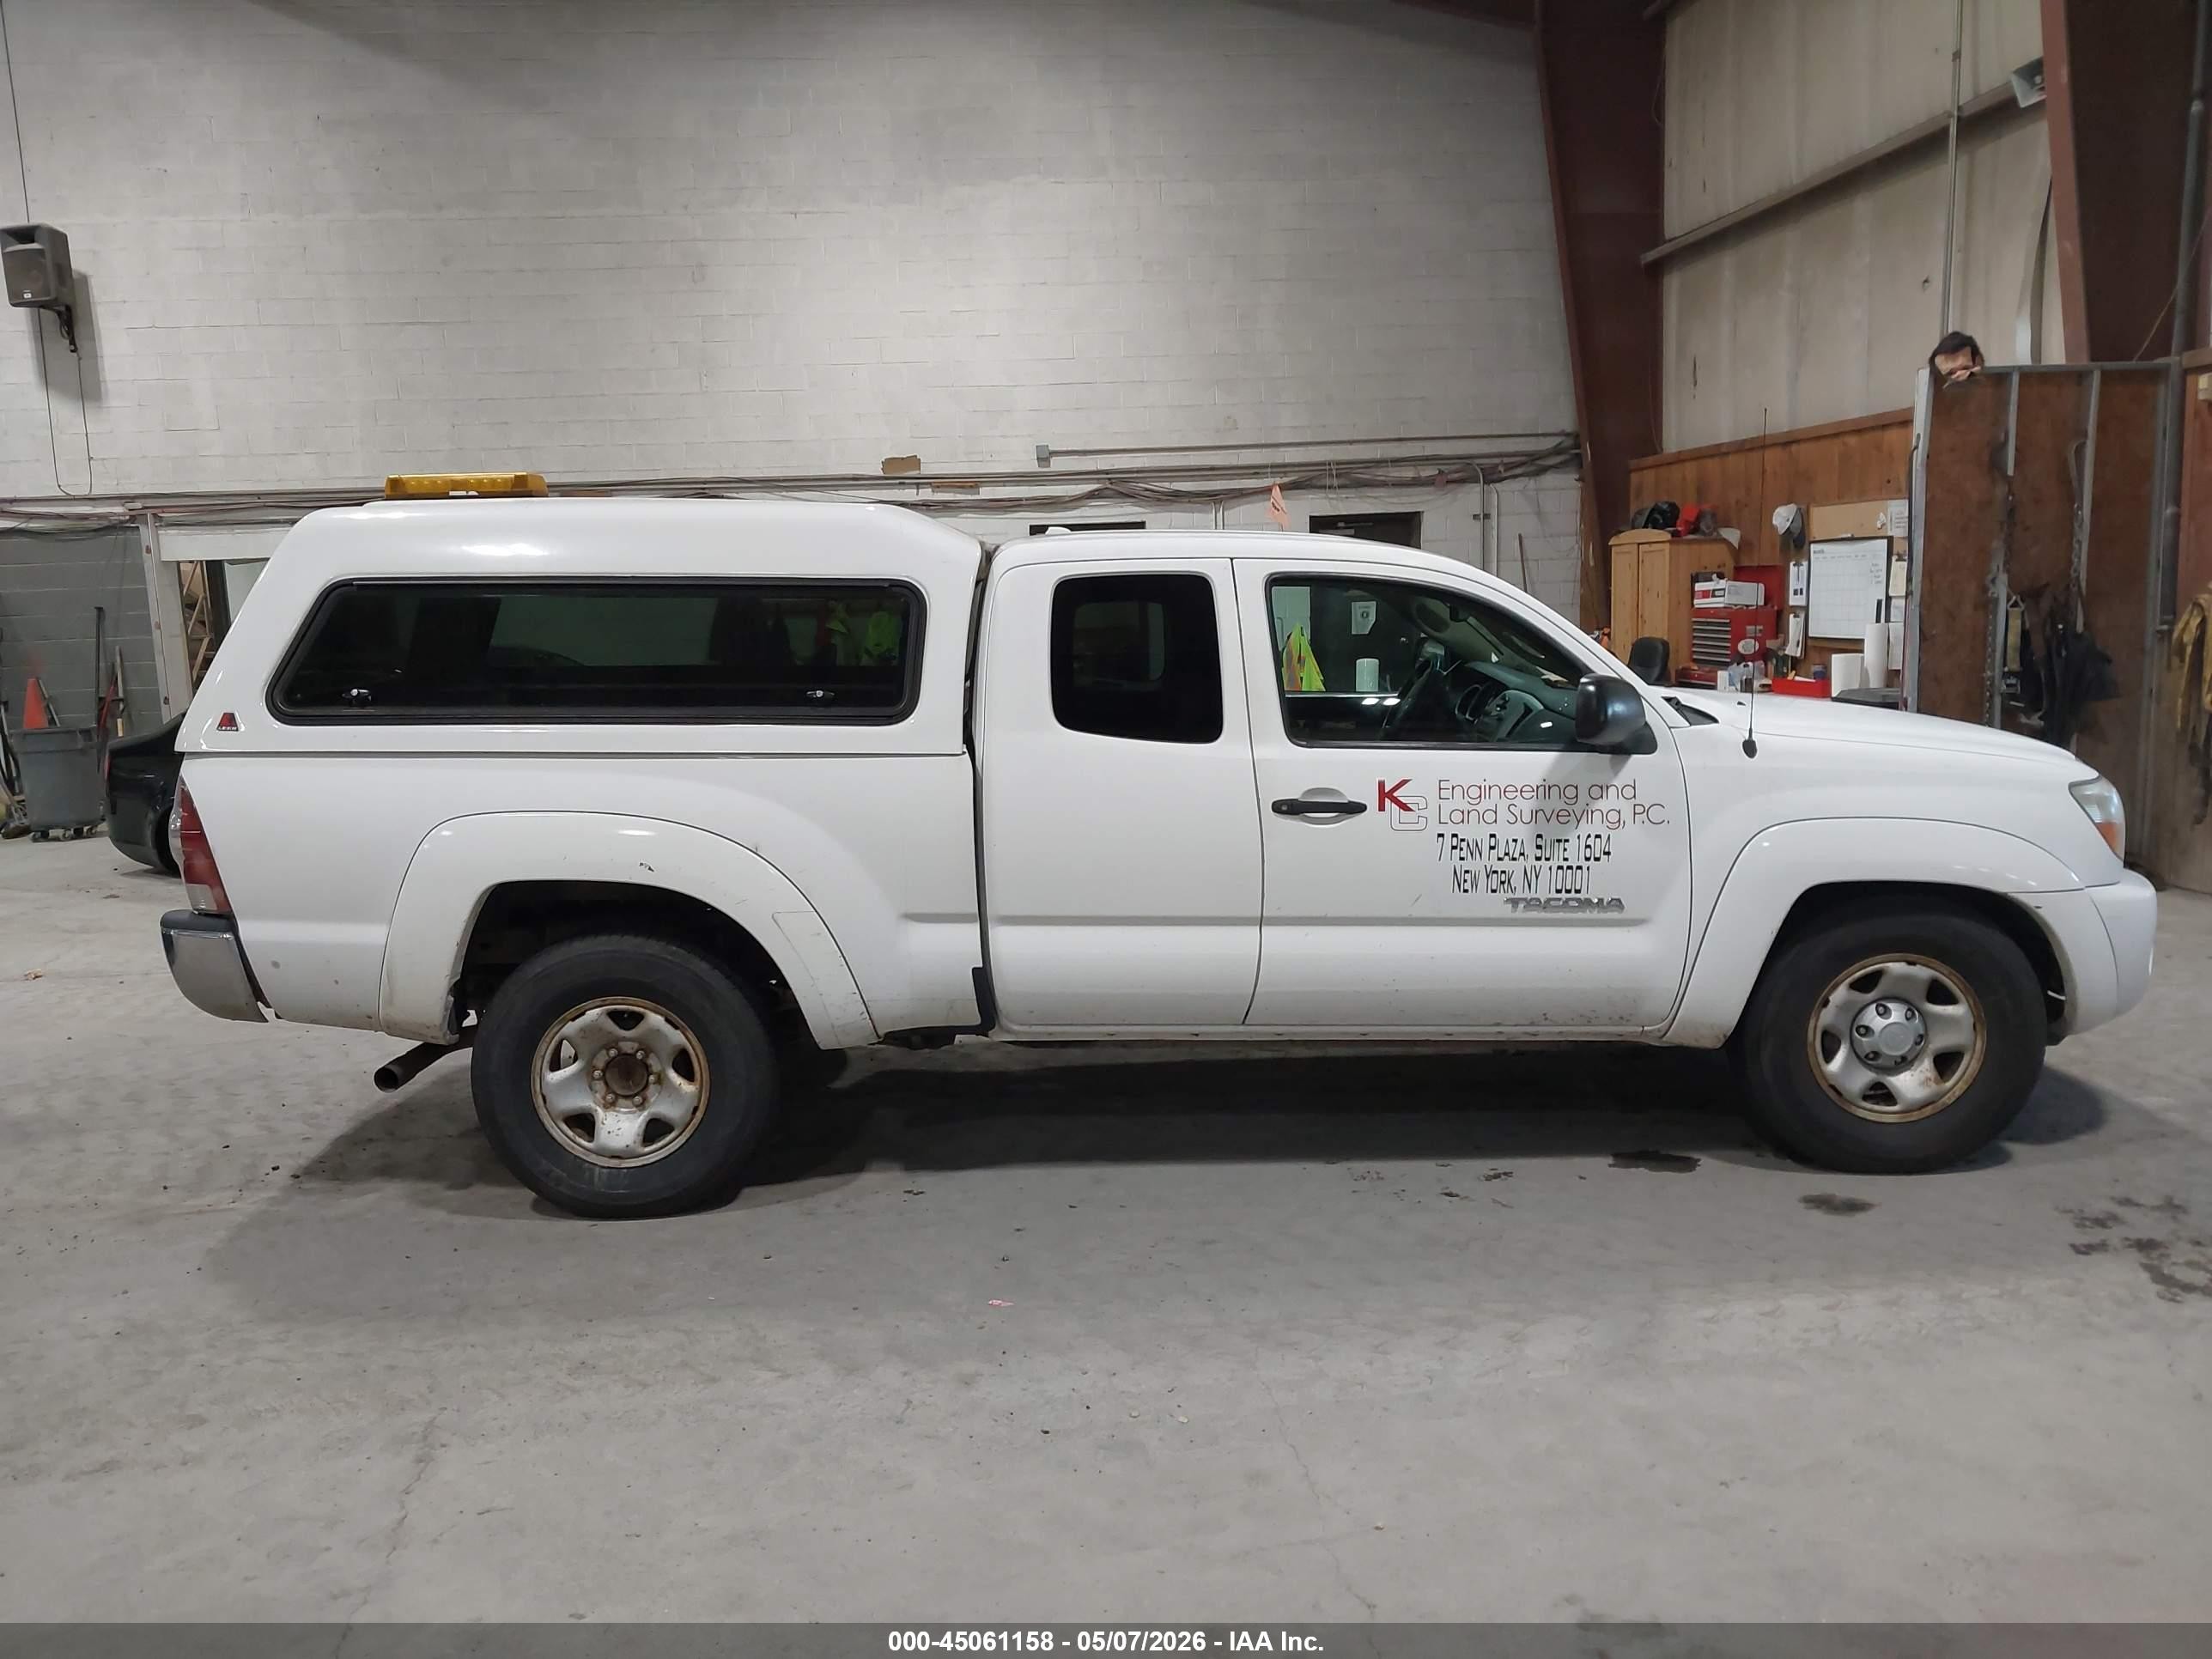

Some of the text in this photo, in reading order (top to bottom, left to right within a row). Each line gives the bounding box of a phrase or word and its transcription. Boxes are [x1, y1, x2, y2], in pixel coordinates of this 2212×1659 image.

[1437, 778, 1637, 805] Engineering and
[1437, 803, 1670, 830] Land Surveying, P.C.
[1437, 833, 1444, 862] 7
[1576, 833, 1612, 863] 1604
[1522, 864, 1542, 894] NY
[1548, 864, 1591, 895] 10001
[1504, 897, 1626, 914] TACOMA
